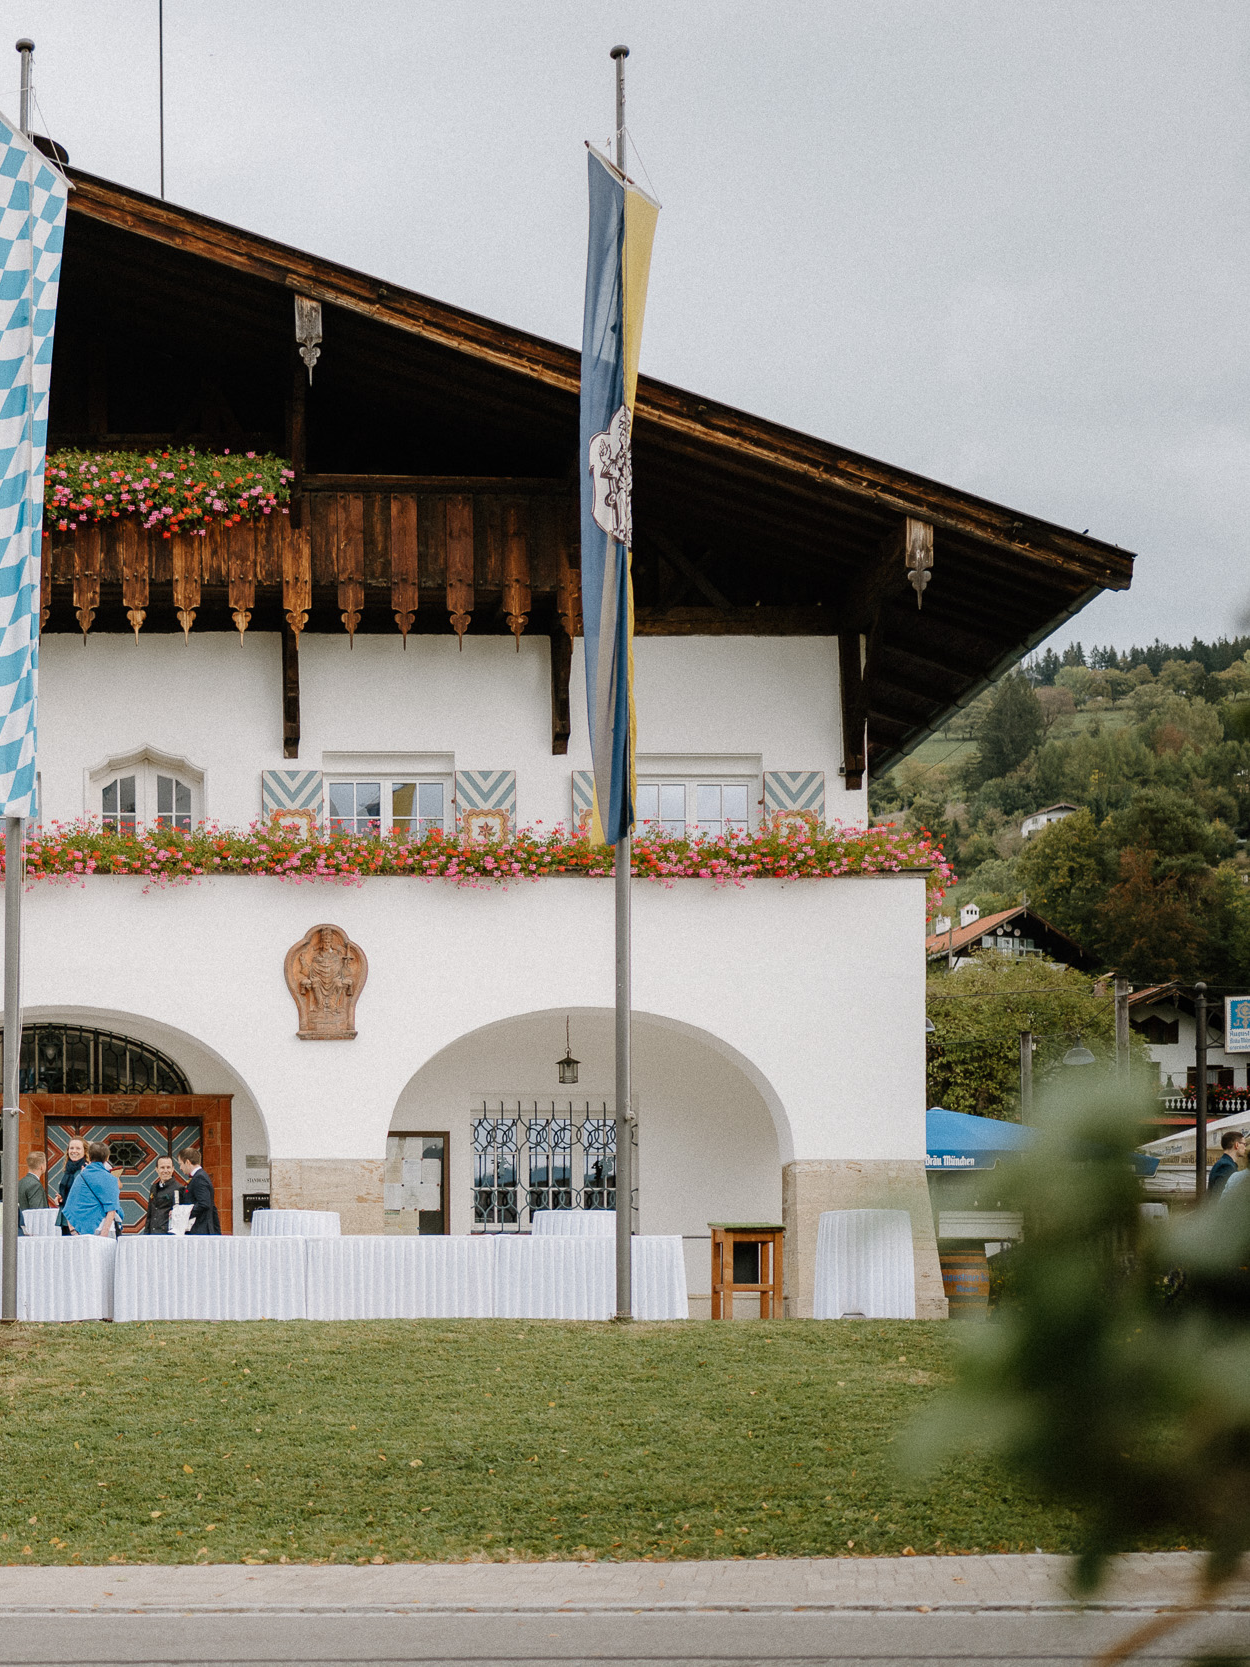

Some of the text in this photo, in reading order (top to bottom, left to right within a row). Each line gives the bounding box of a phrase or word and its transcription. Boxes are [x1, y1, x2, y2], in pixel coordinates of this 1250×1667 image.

[925, 1154, 975, 1166] Bräu München
[941, 1273, 979, 1283] ugustiner
